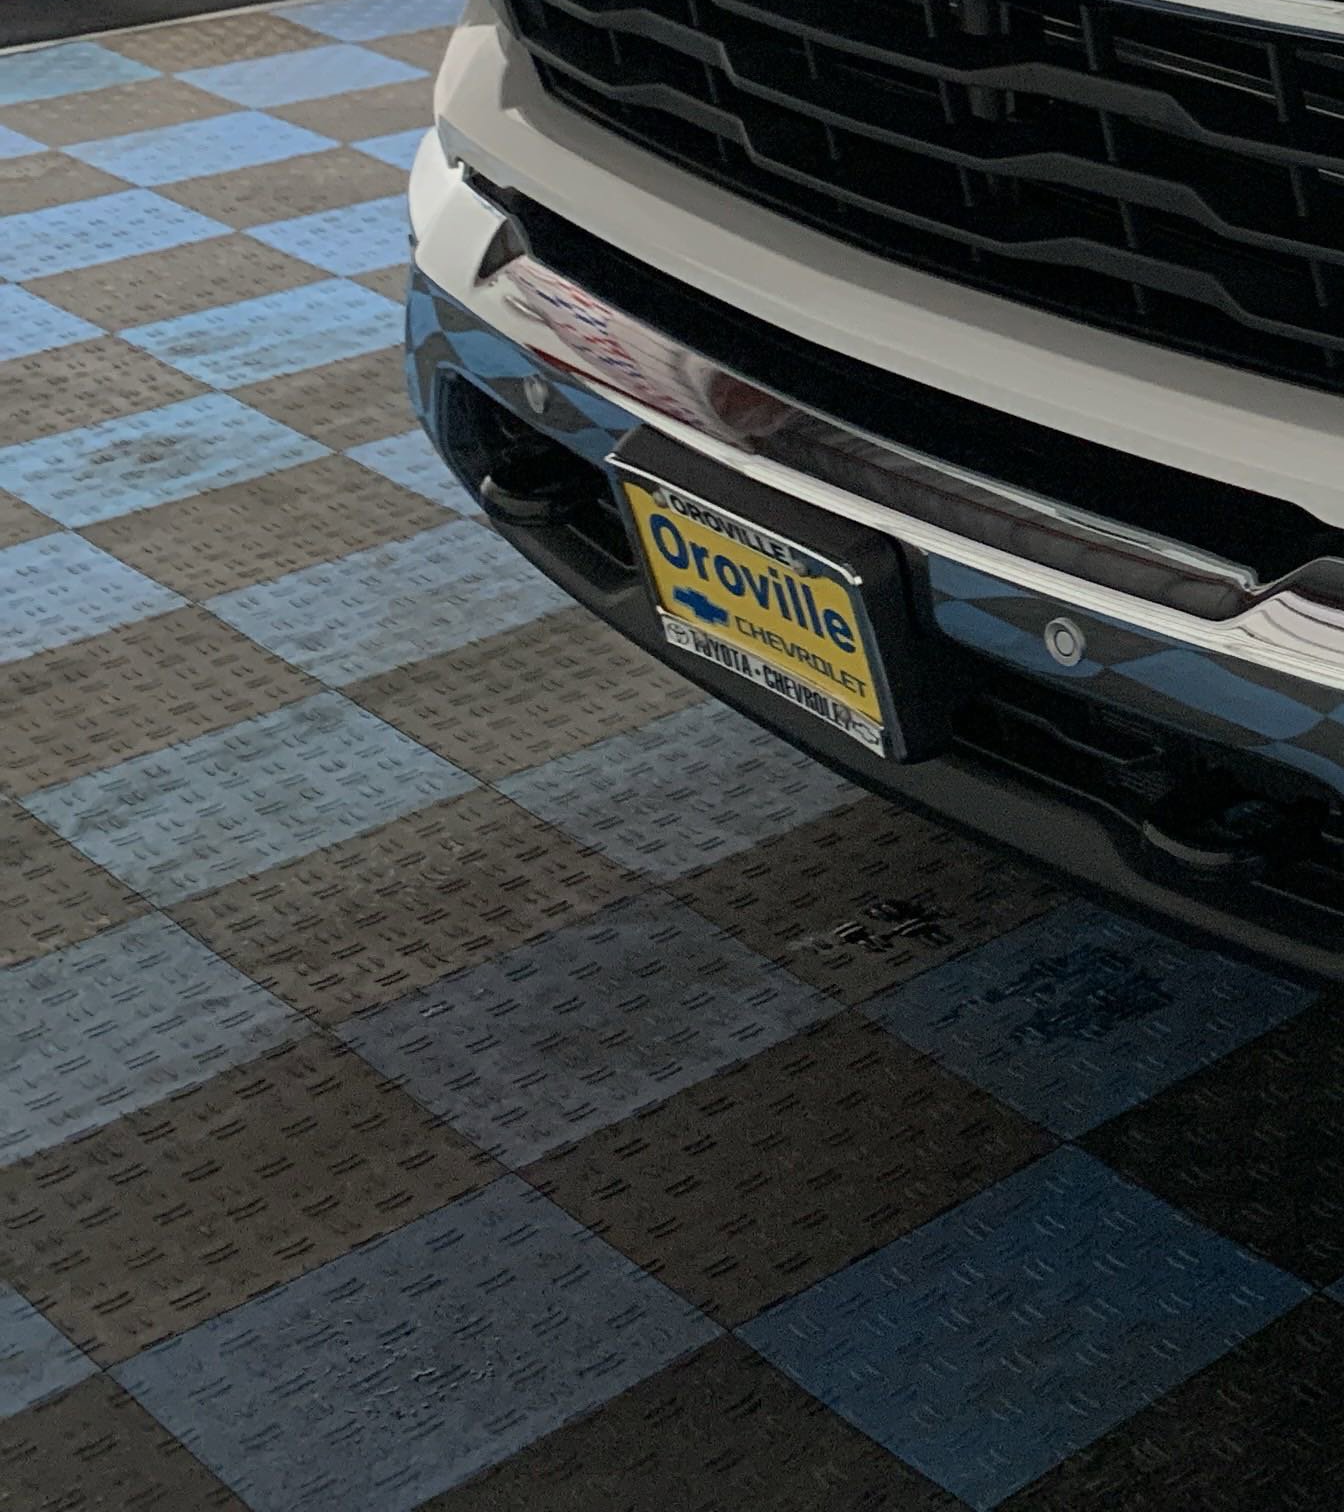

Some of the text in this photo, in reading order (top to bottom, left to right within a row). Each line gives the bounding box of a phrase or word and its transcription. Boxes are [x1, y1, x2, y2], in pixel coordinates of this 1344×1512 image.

[670, 494, 792, 566] OROVILLE
[650, 514, 857, 654] Oroville
[735, 616, 867, 699] CHEVROLET
